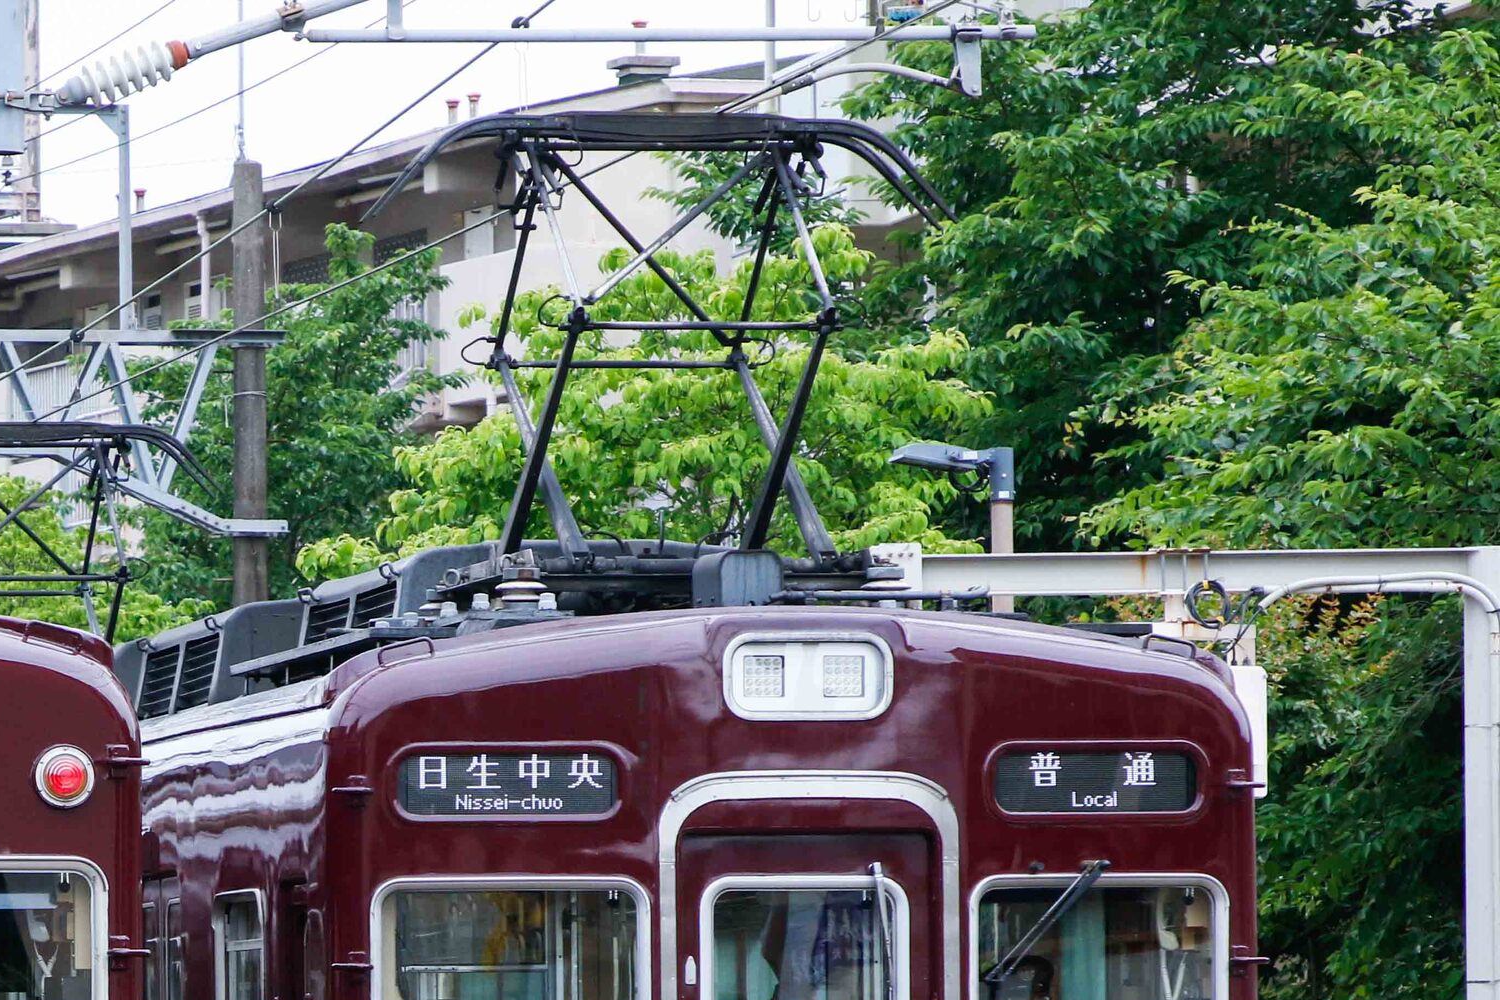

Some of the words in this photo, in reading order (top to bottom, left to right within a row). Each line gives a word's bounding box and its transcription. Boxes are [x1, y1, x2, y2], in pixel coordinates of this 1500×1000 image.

[415, 753, 605, 791] 日生中央
[1027, 751, 1159, 788] 普通
[453, 793, 564, 812] Nissei-chuo
[1071, 791, 1120, 809] Local
